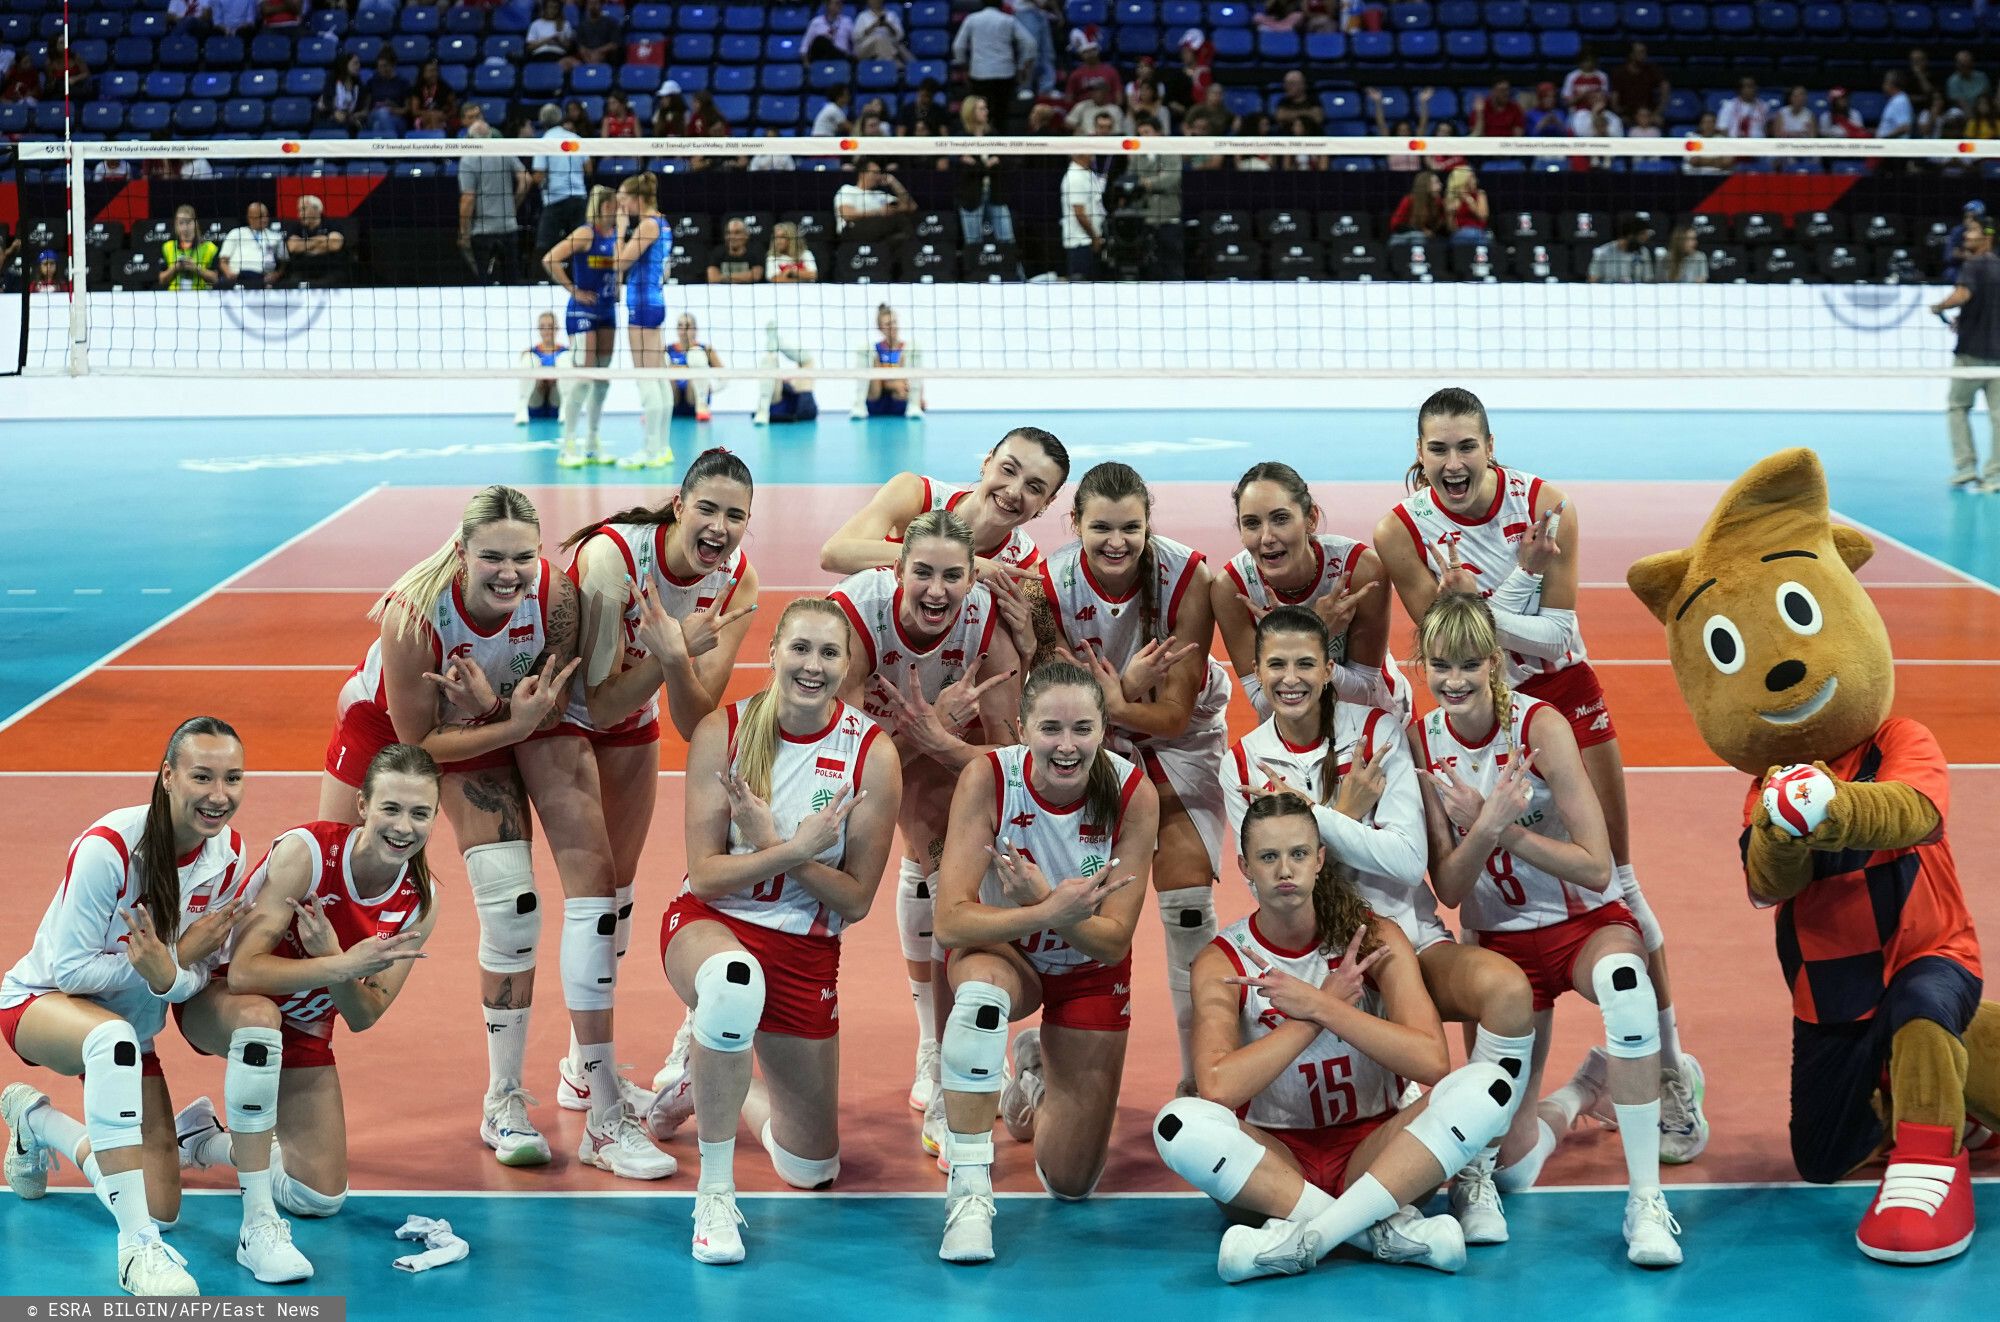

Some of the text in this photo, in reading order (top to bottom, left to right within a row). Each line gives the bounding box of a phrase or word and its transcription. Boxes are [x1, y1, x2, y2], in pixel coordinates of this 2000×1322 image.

[815, 768, 843, 780] POLSKA
[1486, 847, 1527, 907] 8
[668, 912, 682, 933] 6
[1298, 1055, 1358, 1128] 15
[109, 1190, 120, 1205] F
